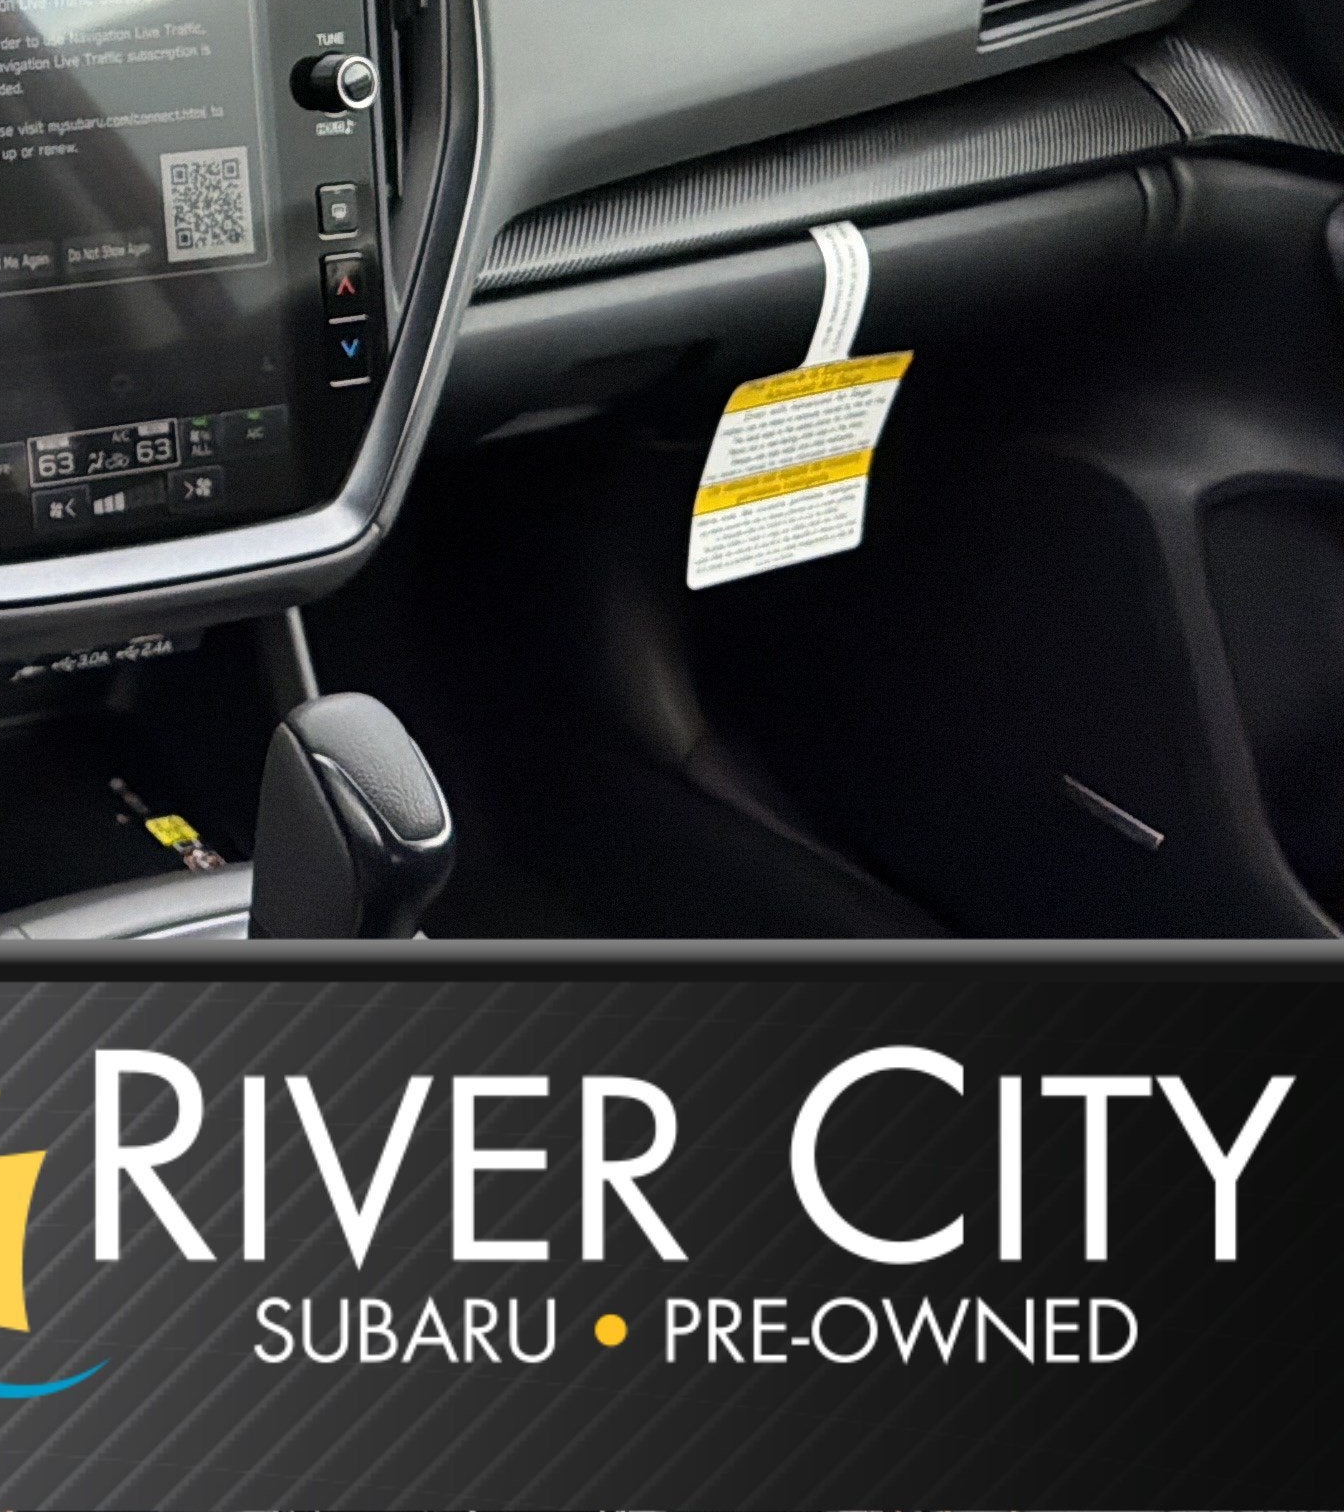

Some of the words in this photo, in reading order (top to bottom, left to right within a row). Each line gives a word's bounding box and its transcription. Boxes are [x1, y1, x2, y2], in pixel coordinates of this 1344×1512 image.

[25, 35, 40, 49] to
[316, 31, 345, 47] TUNE
[53, 55, 80, 70] Live
[16, 120, 45, 137] visit
[1, 148, 18, 163] up
[20, 146, 34, 160] or
[135, 437, 172, 464] 63
[37, 451, 75, 477] 63
